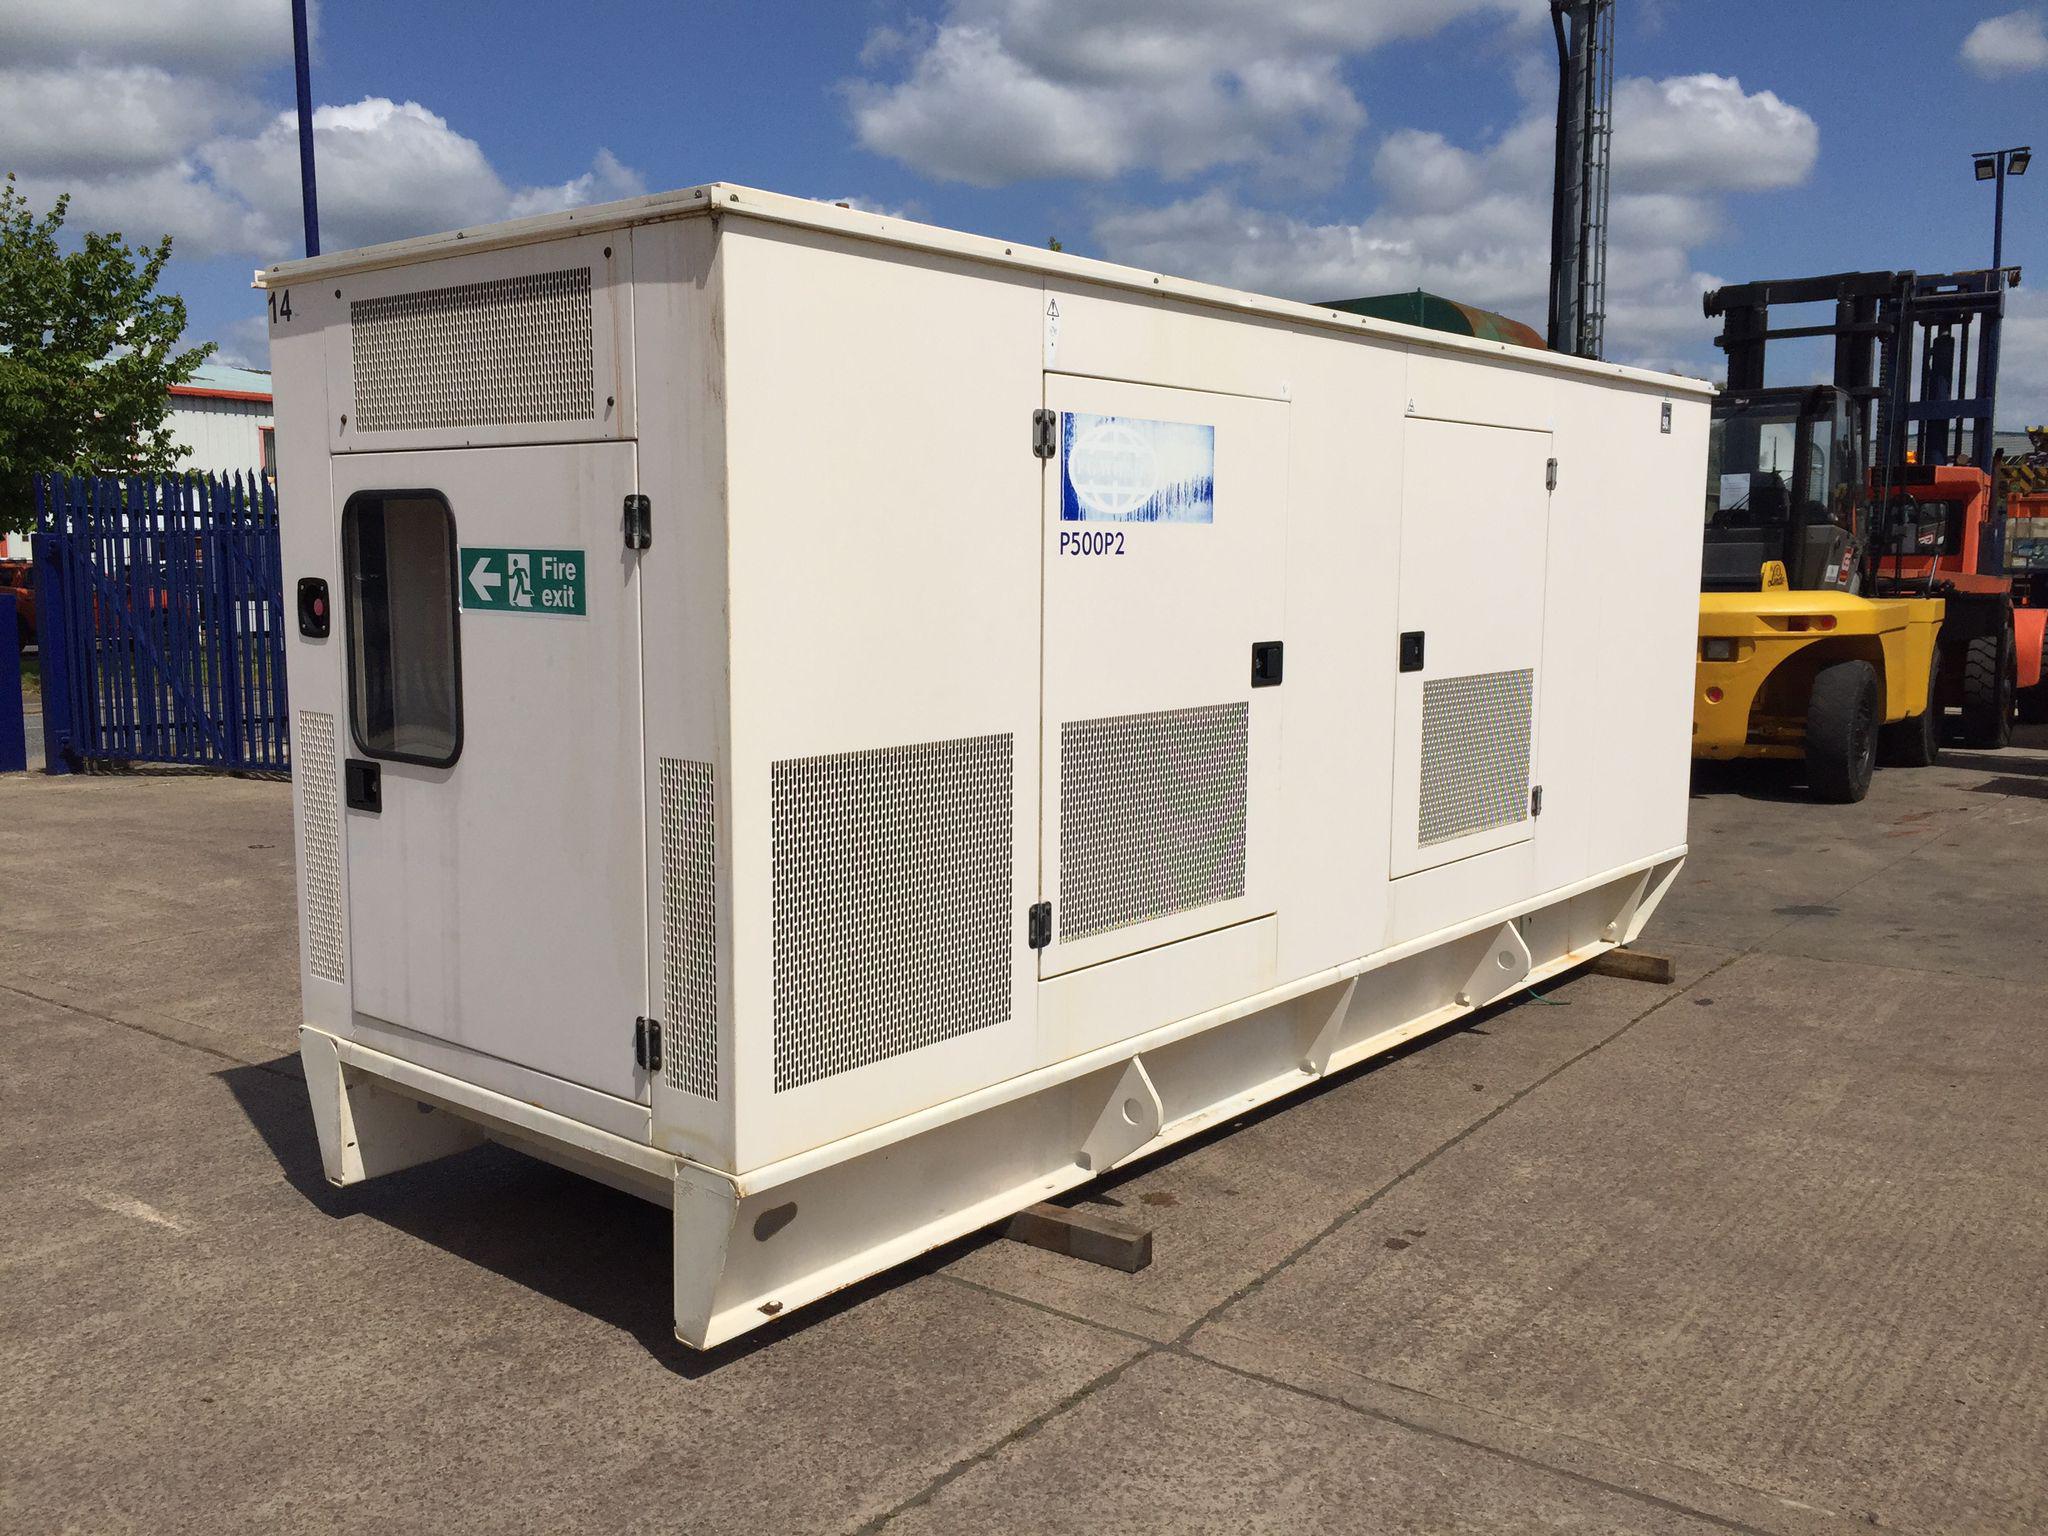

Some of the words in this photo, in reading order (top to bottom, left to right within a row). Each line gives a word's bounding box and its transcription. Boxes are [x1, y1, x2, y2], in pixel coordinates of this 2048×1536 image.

[268, 289, 292, 324] 14
[1060, 532, 1125, 555] P500P2
[541, 556, 577, 581] Fire
[541, 584, 575, 608] exit
